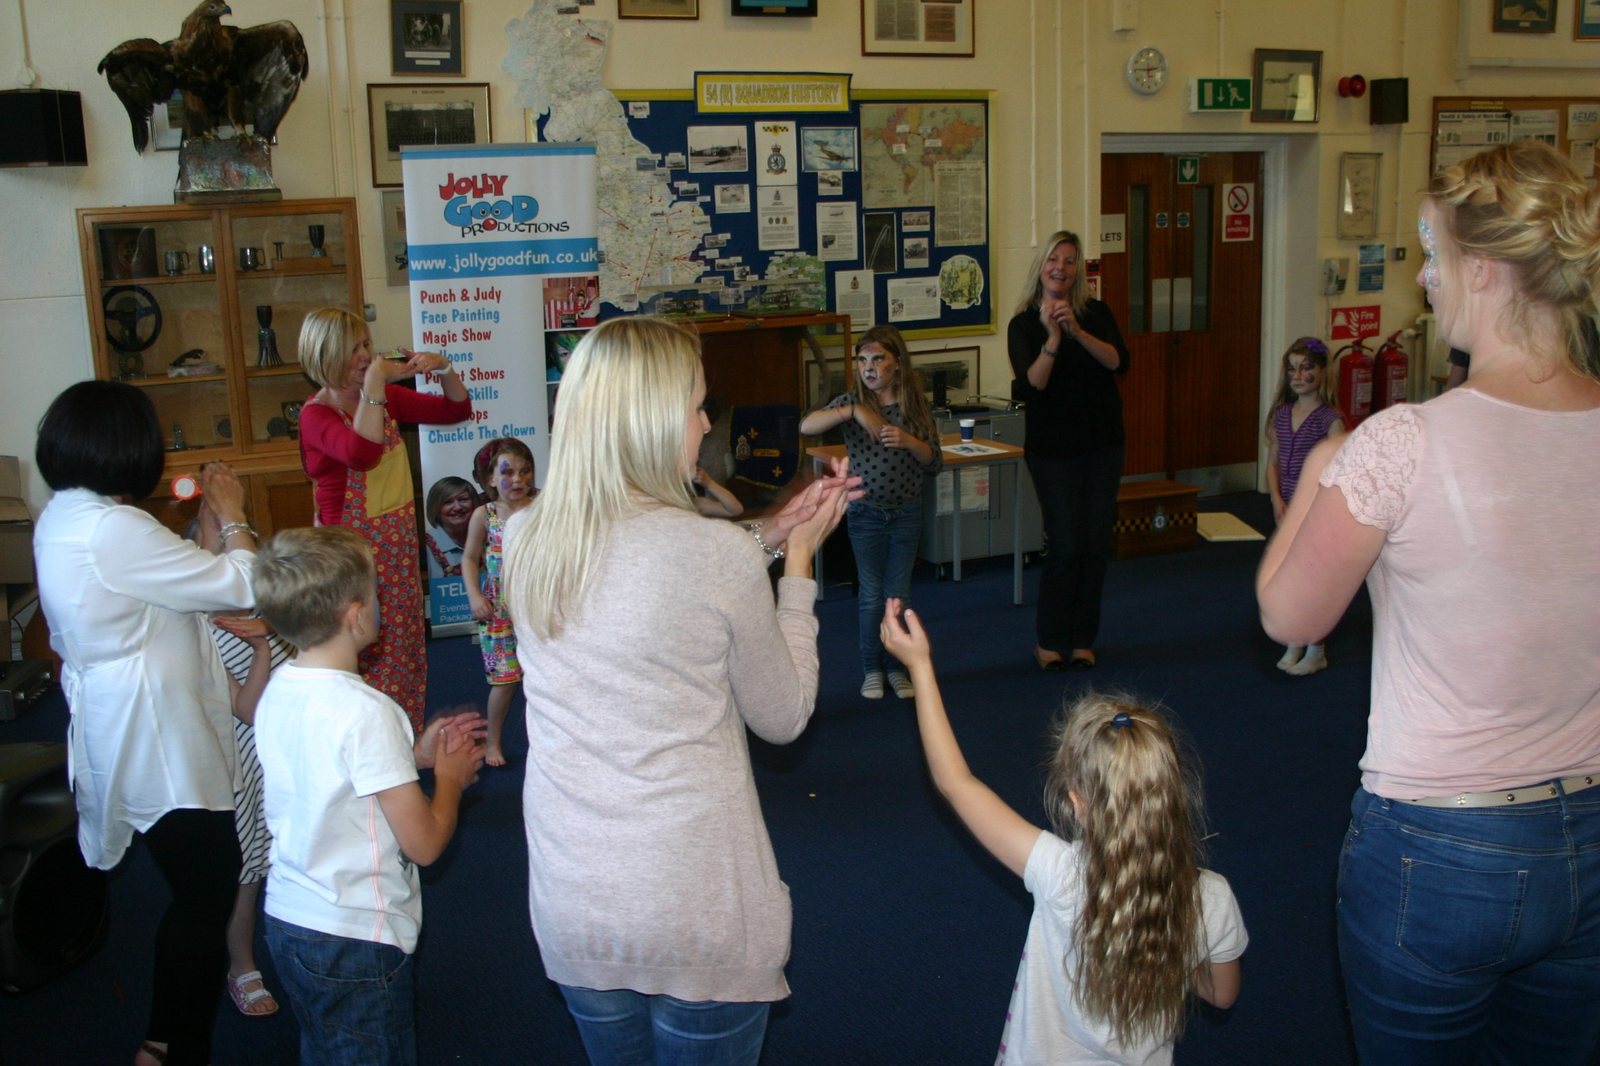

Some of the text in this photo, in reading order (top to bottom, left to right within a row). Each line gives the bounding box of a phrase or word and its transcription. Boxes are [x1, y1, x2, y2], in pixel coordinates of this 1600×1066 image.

[735, 82, 790, 104] SQUADRON
[791, 82, 840, 104] HISTORY
[439, 173, 508, 200] JOLLY
[443, 195, 539, 227] GOOD
[461, 218, 570, 238] PRODUCTIONS
[1100, 232, 1122, 242] LETS
[410, 248, 598, 273] www.jollygoodfun.co.uk
[420, 286, 501, 304] Punch & Judy
[421, 308, 500, 324] Face Painting
[1360, 311, 1374, 320] Fire
[1360, 321, 1379, 332] point
[422, 328, 491, 347] Magic Show
[469, 368, 505, 381] Shows
[468, 386, 499, 401] Skills
[428, 424, 536, 444] Chuckle The Clown
